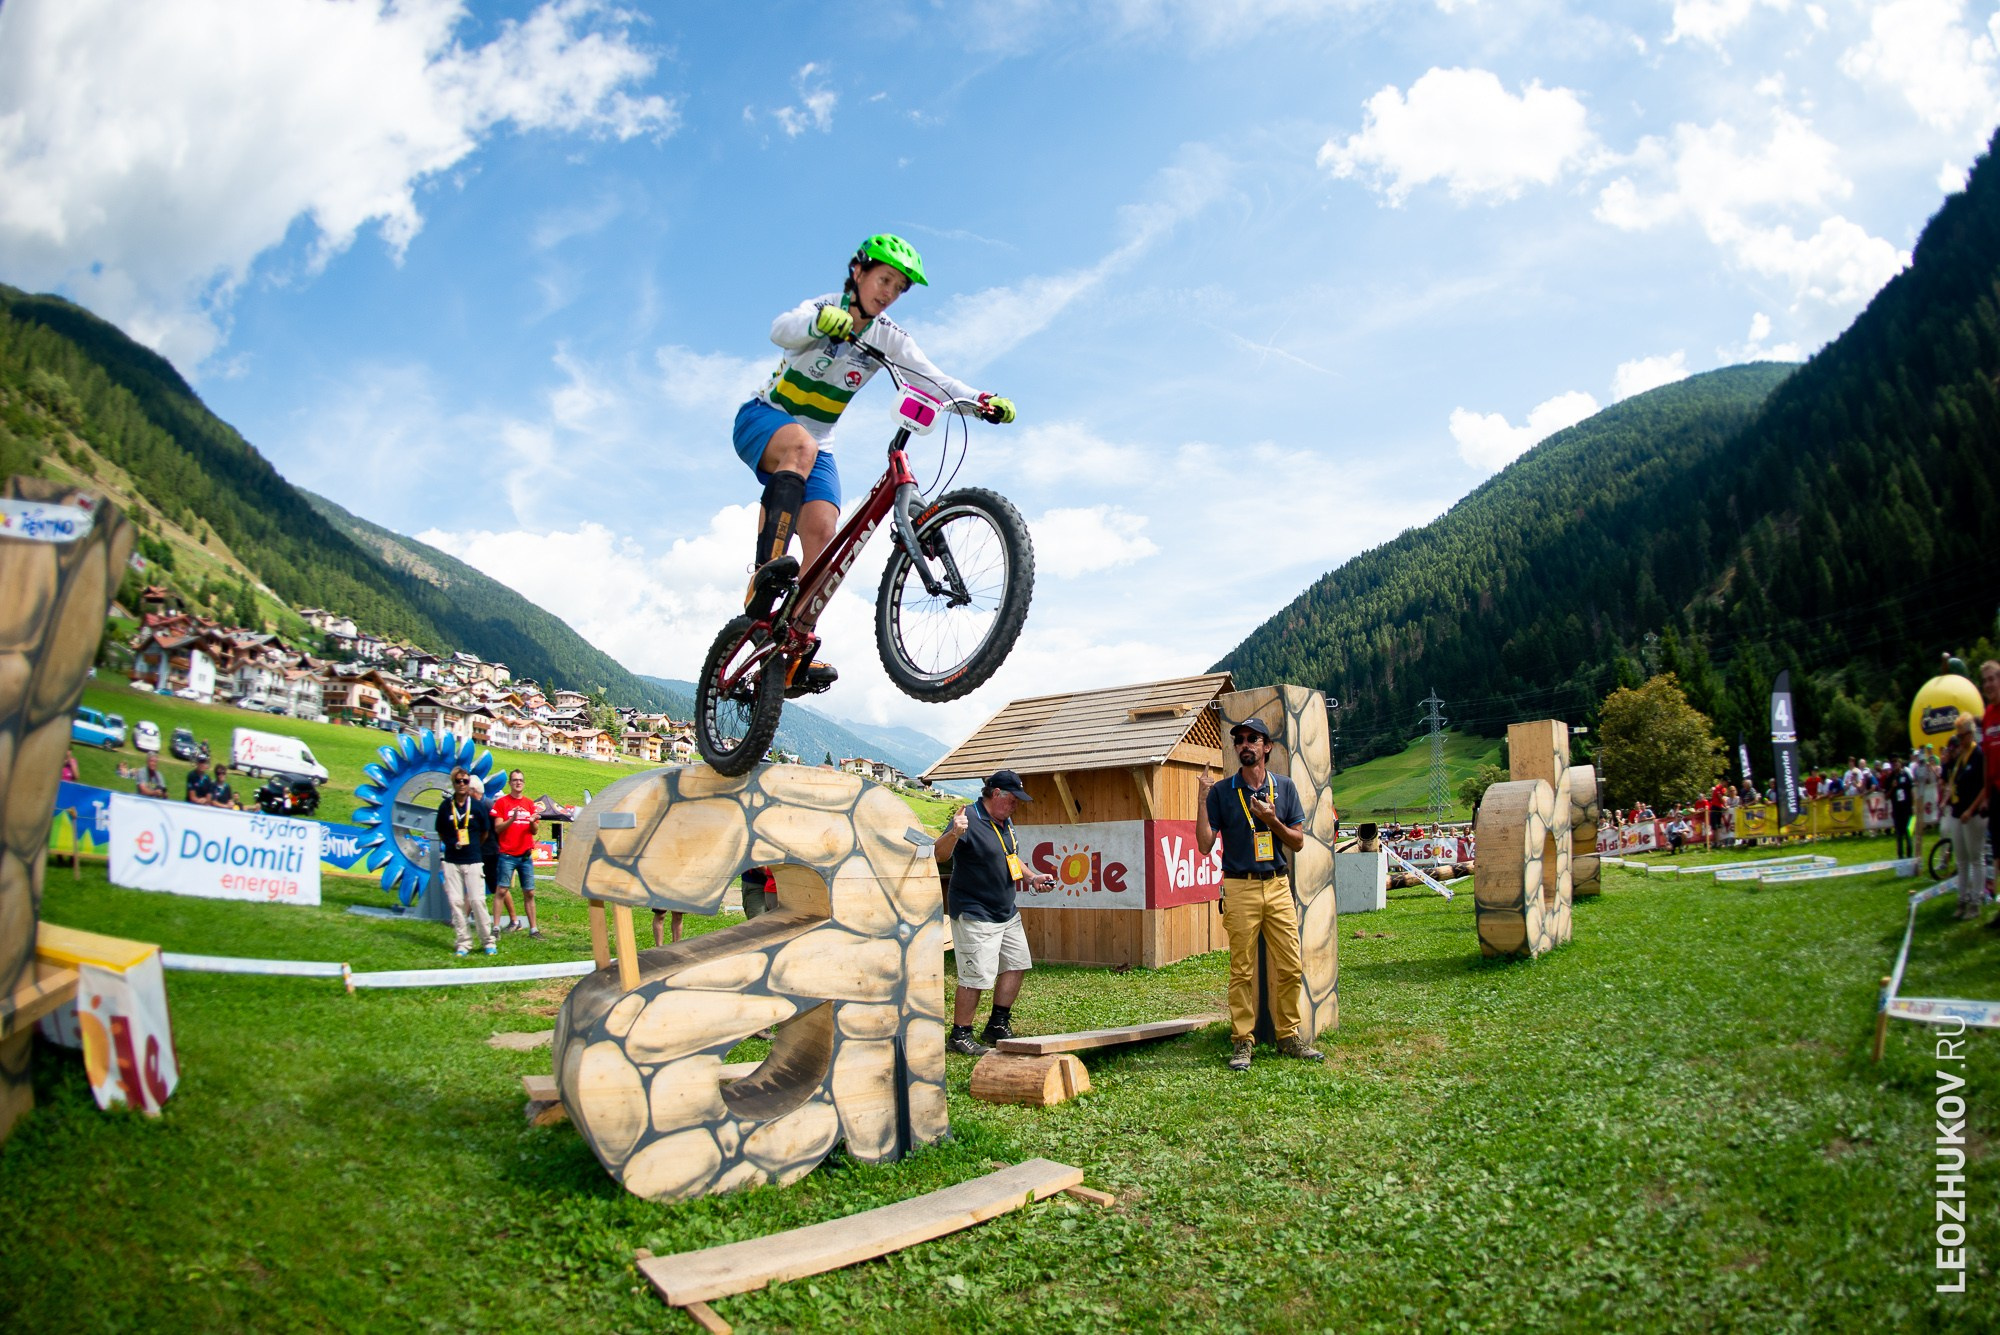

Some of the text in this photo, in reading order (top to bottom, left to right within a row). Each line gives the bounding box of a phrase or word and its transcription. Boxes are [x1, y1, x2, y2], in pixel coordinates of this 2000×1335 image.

[914, 405, 925, 422] 1
[1775, 699, 1789, 727] 4
[1781, 750, 1798, 813] #TrialsWorlds
[249, 815, 307, 840] Hydro
[180, 829, 304, 873] Dolomiti
[1160, 835, 1194, 893] Val
[1196, 858, 1210, 886] di
[1393, 844, 1453, 861] Val di Sole
[1032, 841, 1128, 893] Sole
[220, 873, 298, 898] energia
